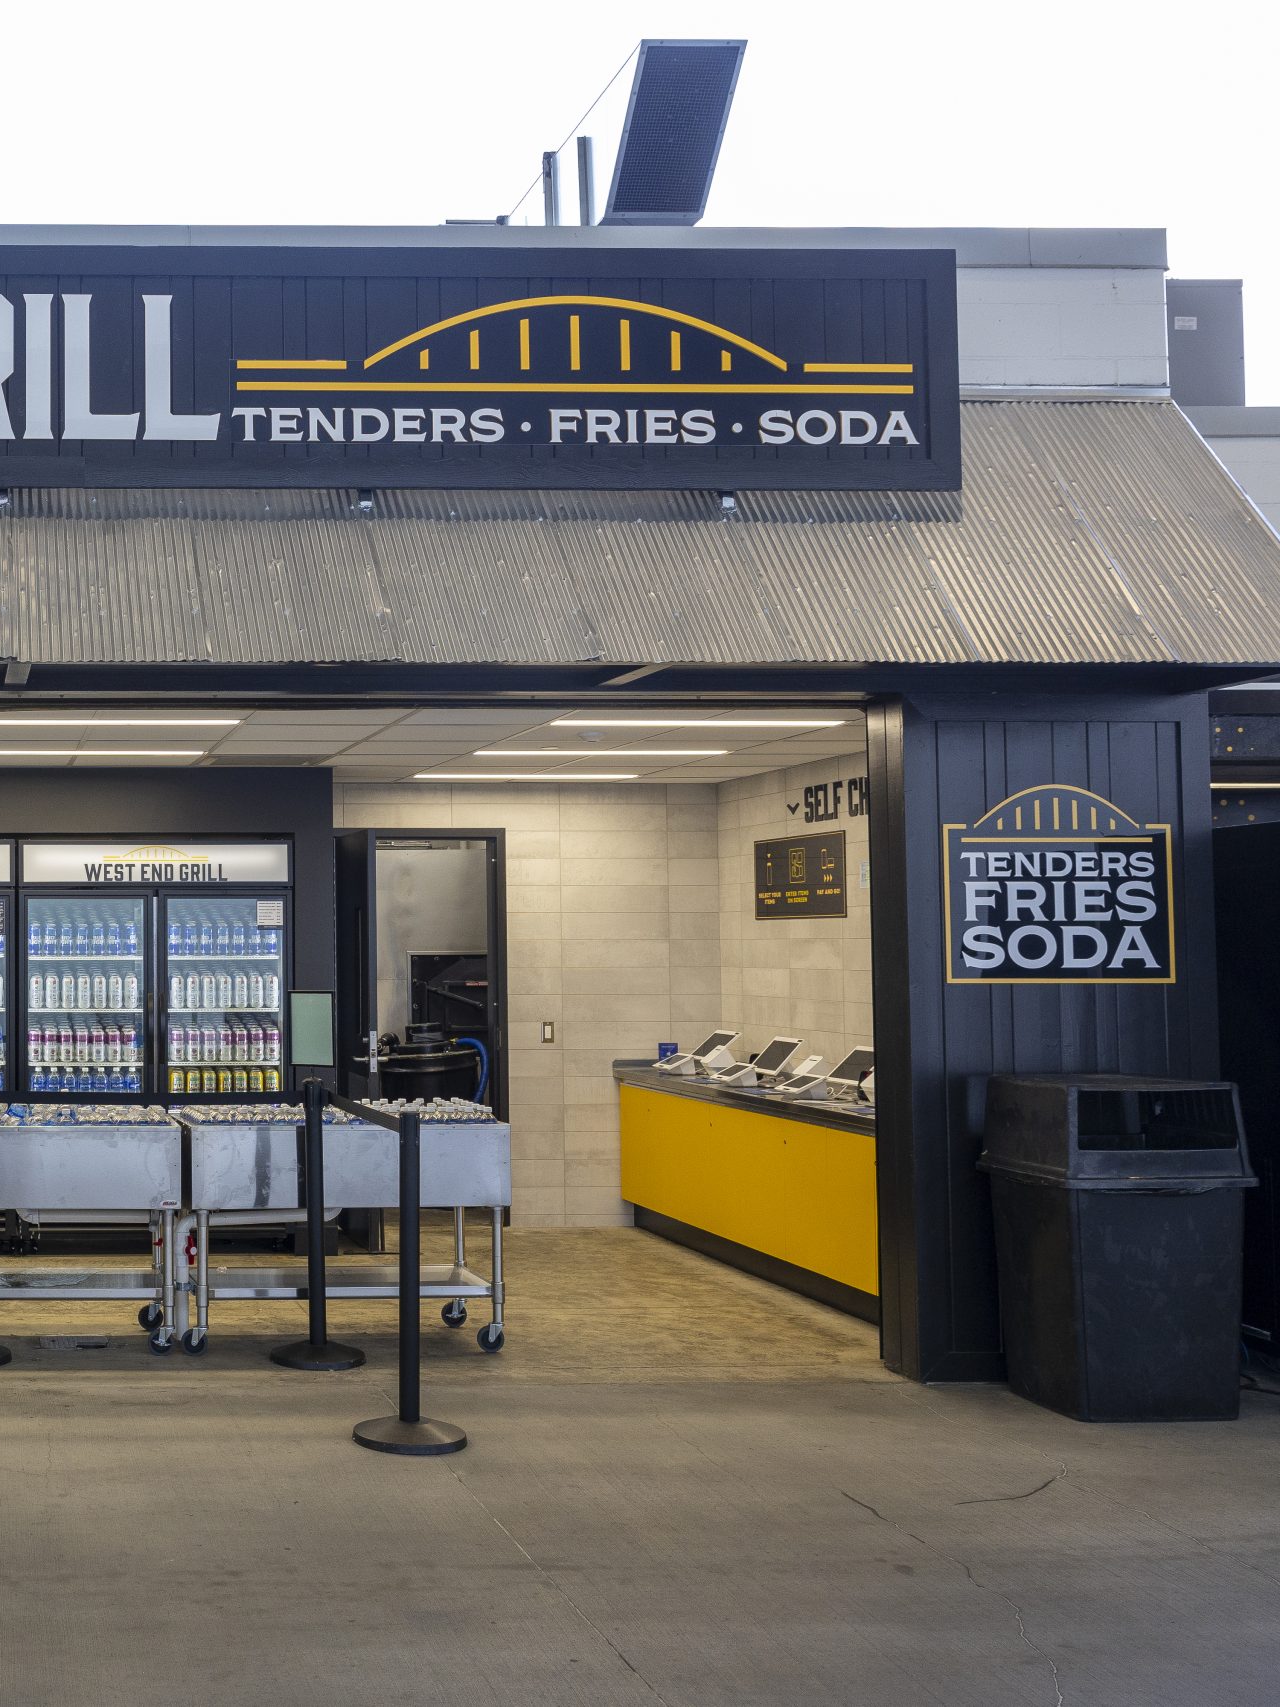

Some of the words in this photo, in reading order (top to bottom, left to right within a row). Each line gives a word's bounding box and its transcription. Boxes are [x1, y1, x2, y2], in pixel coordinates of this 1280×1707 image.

[231, 407, 504, 443] TENDERS
[548, 408, 717, 444] FRIES
[758, 409, 920, 445] SODA
[804, 781, 843, 823] SELF
[84, 863, 136, 882] WEST
[141, 863, 174, 882] END
[179, 863, 228, 882] GRILL
[959, 851, 1156, 878] TENDERS
[963, 880, 1157, 922] FRIES
[961, 924, 1161, 969] SODA
